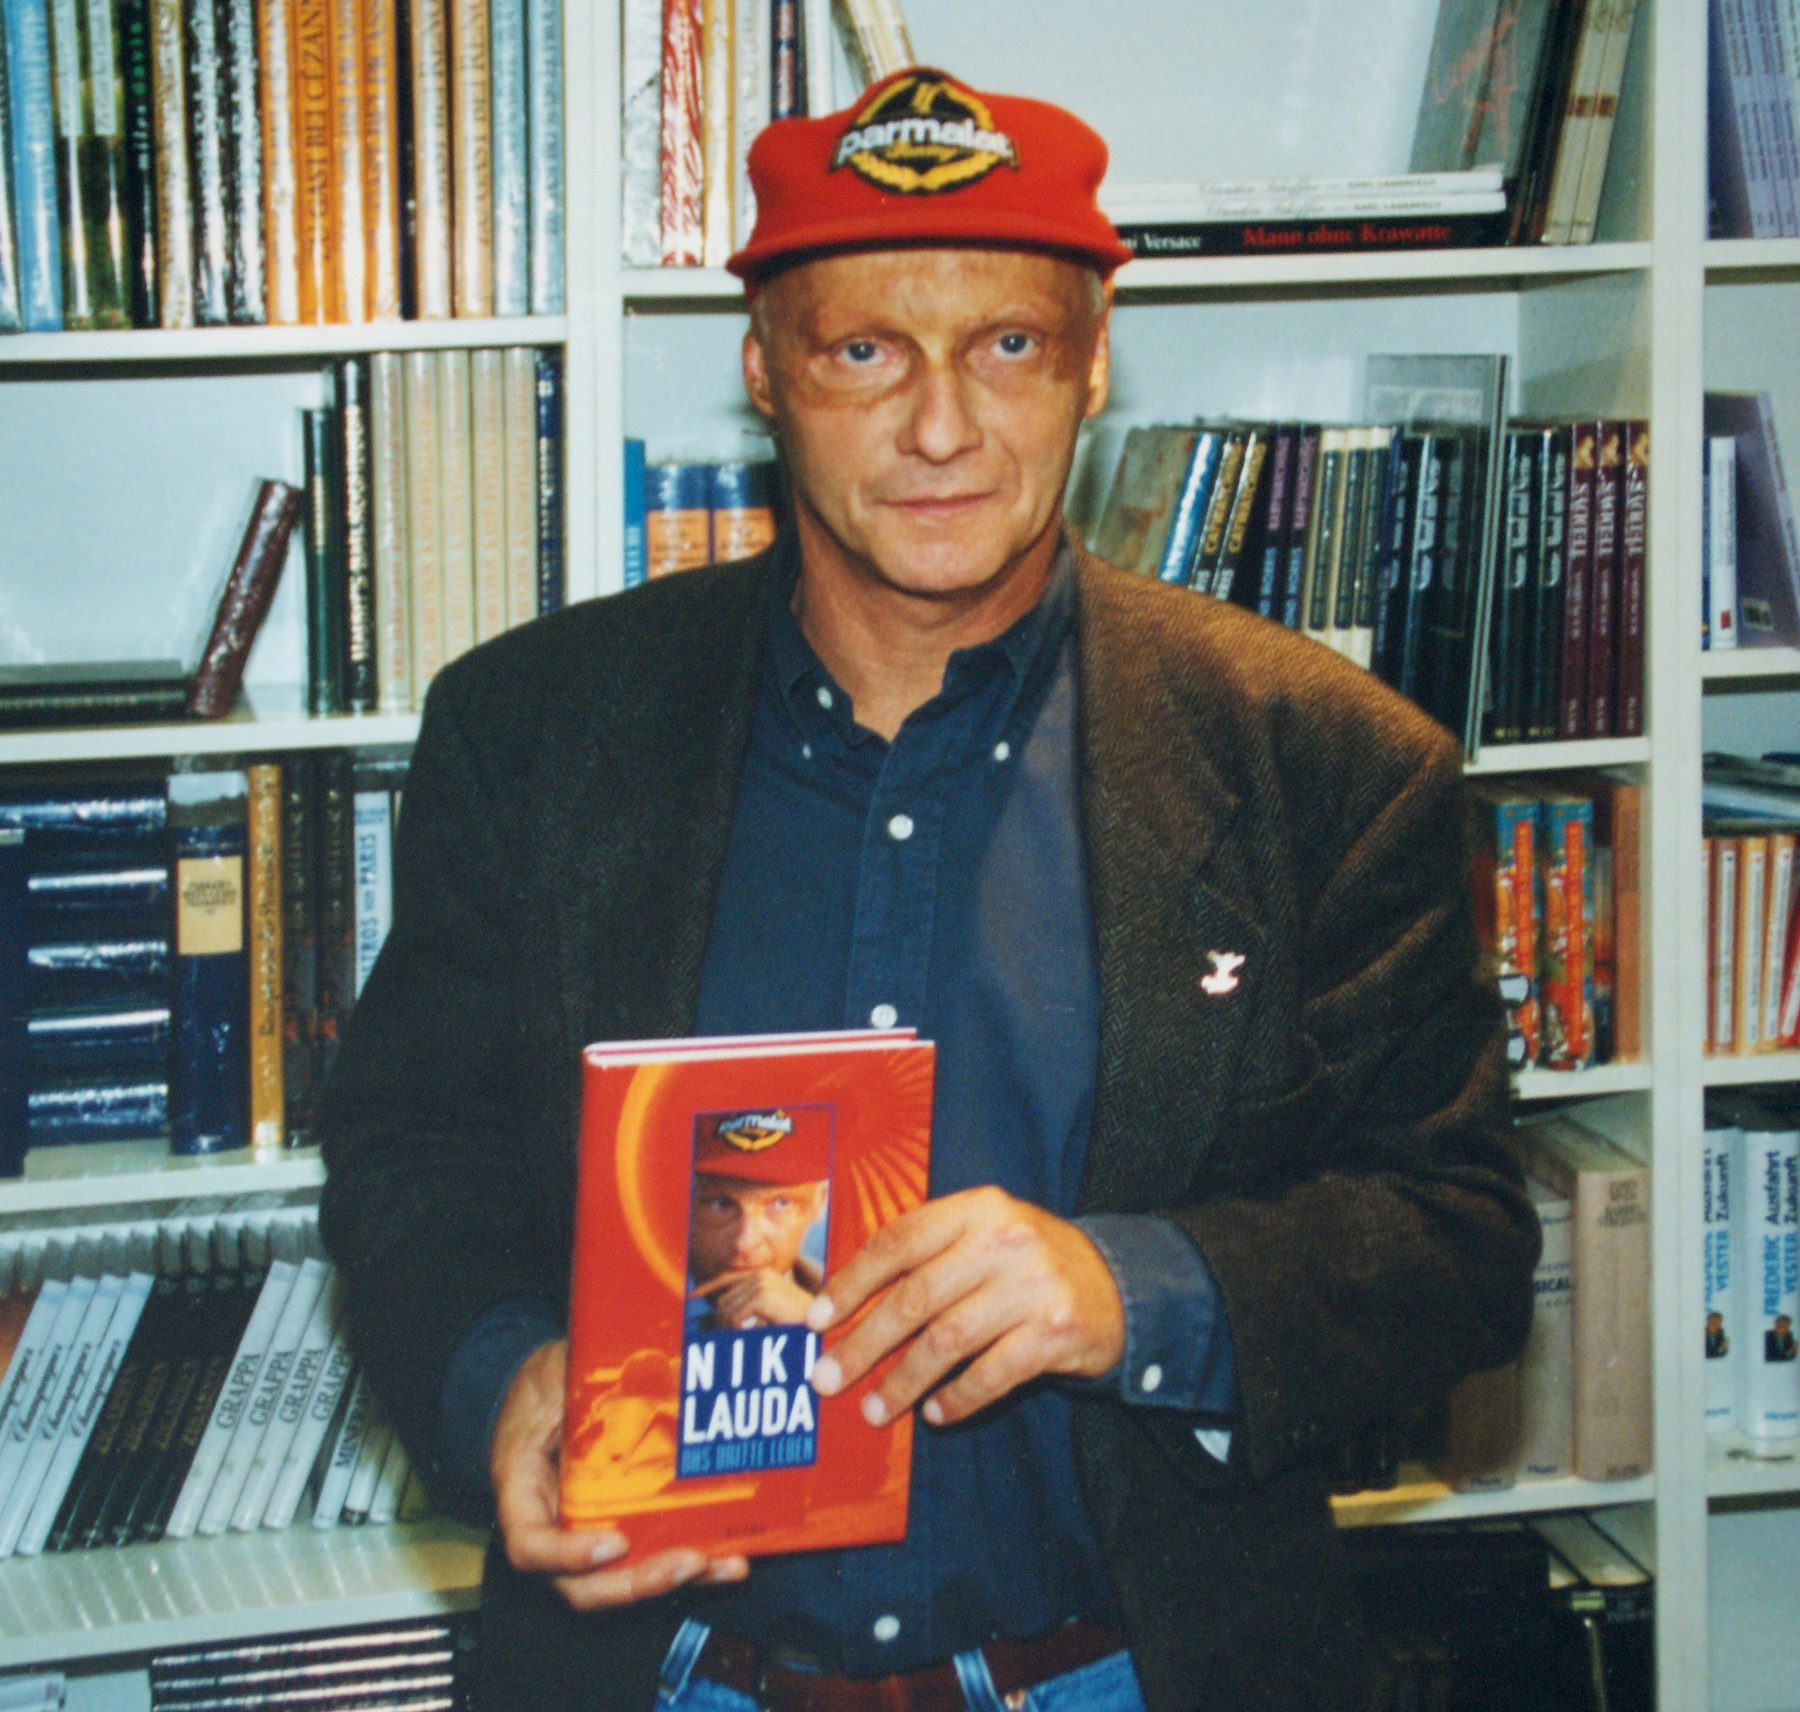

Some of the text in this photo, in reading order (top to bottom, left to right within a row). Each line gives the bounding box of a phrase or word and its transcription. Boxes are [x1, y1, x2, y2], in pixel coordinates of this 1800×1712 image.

[302, 108, 328, 150] BEI
[1242, 225, 1302, 247] Mann
[1308, 223, 1352, 245] ohne
[1361, 222, 1451, 244] Krawatte
[357, 832, 377, 886] PARIS
[214, 1353, 262, 1430] GRAPPA
[248, 1349, 295, 1427] GRAPPA
[278, 1347, 325, 1425] GRAPPA
[685, 1331, 817, 1393] NIKI
[682, 1383, 815, 1445] LAUDA
